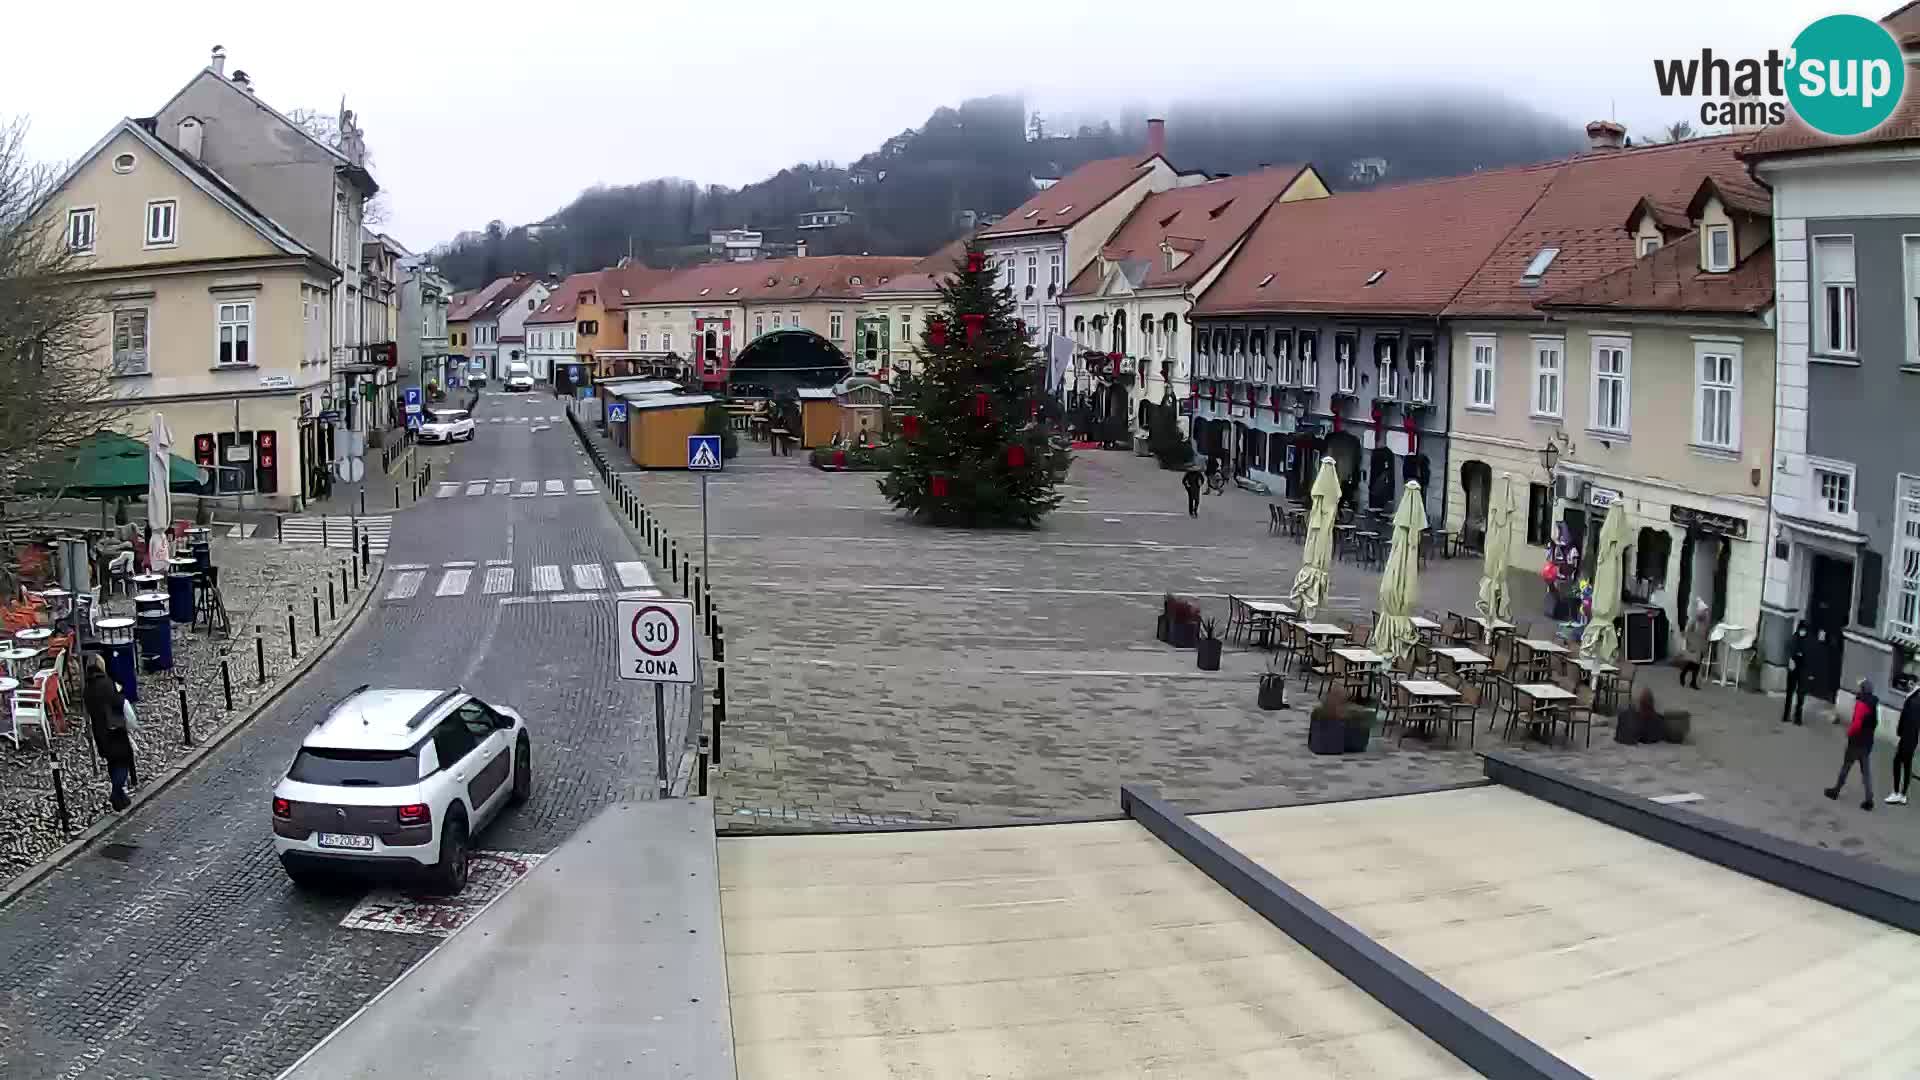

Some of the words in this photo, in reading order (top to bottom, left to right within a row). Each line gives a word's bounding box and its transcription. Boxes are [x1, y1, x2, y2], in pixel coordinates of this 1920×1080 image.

[409, 391, 417, 402] P
[644, 621, 668, 642] 30
[634, 659, 678, 675] ZONA
